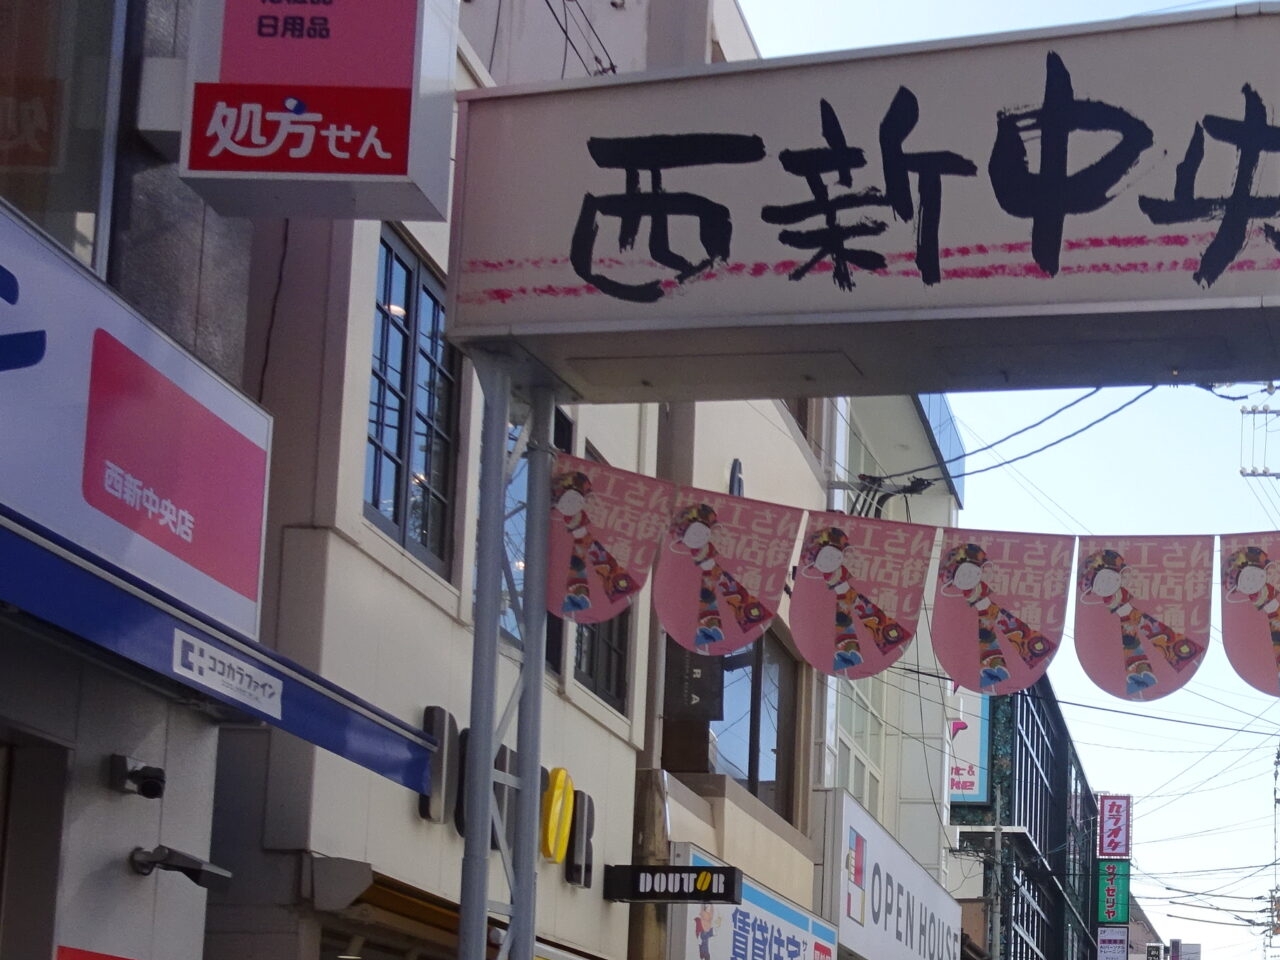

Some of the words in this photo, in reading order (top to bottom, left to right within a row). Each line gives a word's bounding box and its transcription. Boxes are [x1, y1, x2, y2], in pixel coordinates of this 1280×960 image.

[257, 16, 331, 38] 日用品
[206, 101, 392, 159] 処方せん
[104, 460, 195, 543] 西新中央店
[208, 655, 276, 699] ココカラファイン
[1107, 802, 1122, 851] カラオケ
[639, 870, 725, 894] DOUTOR
[871, 862, 915, 949] OPEN
